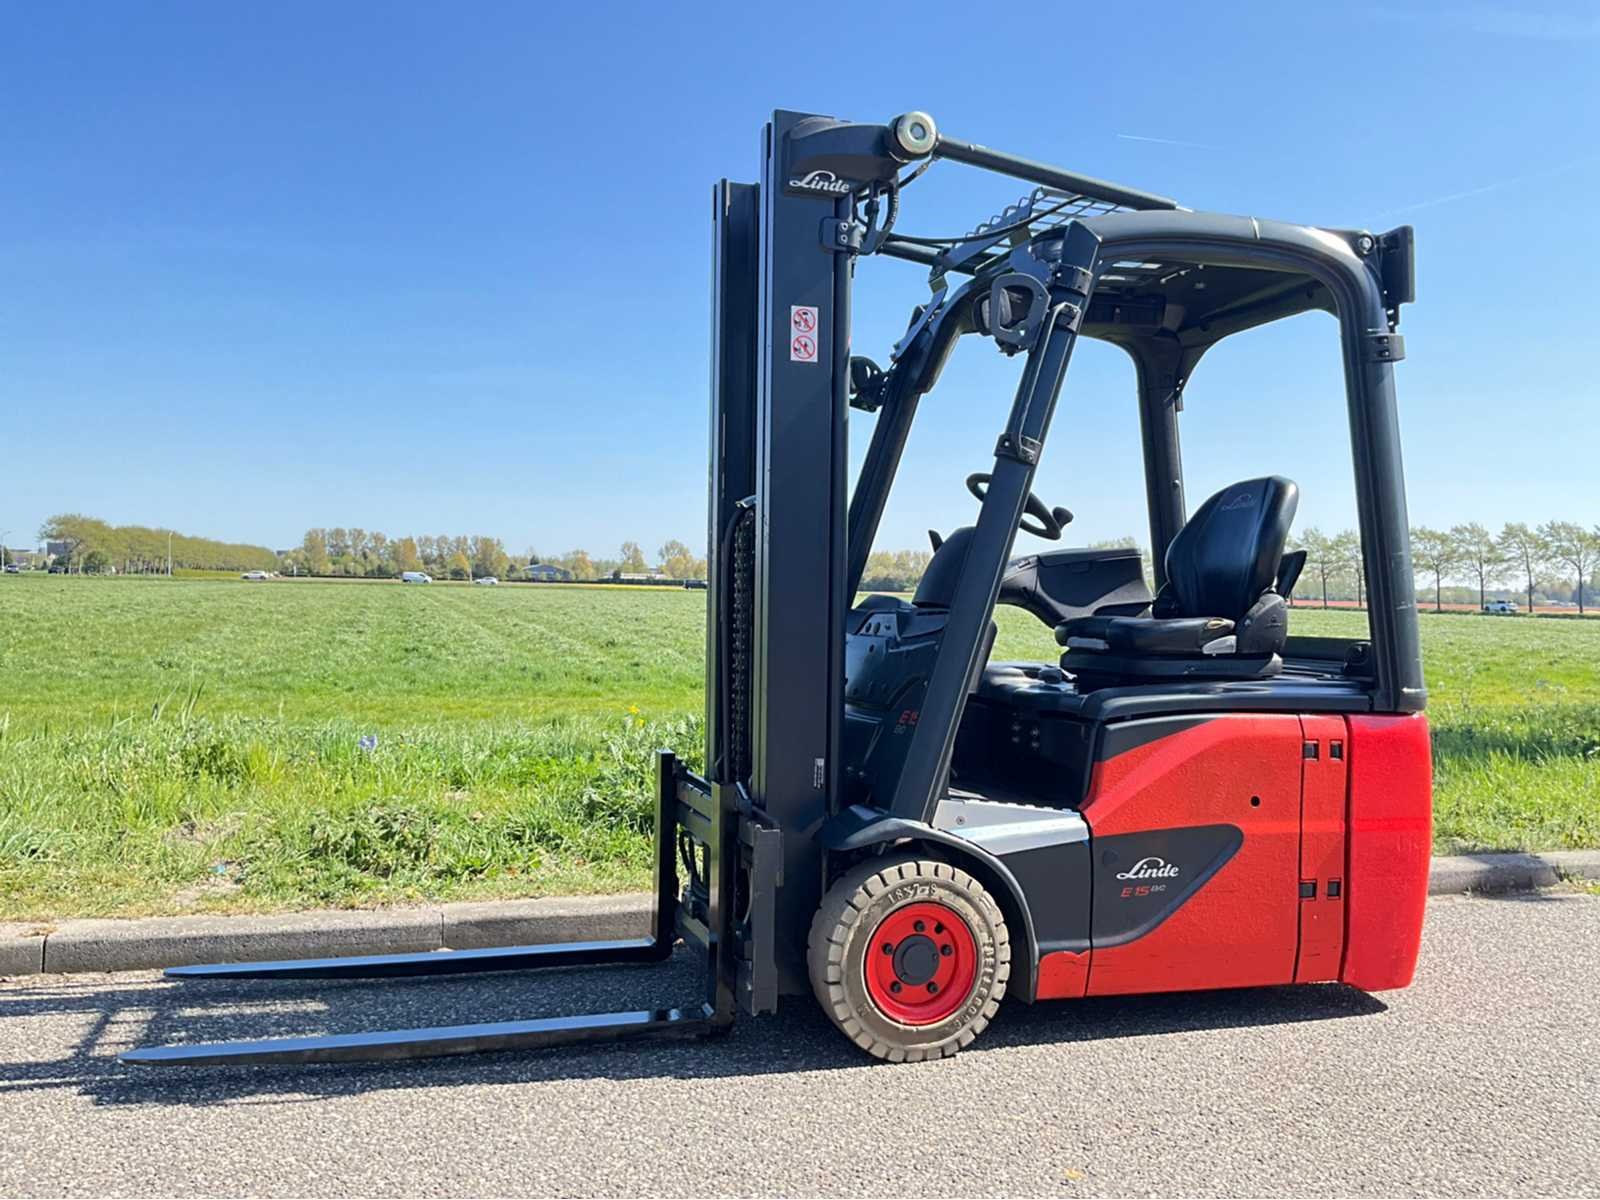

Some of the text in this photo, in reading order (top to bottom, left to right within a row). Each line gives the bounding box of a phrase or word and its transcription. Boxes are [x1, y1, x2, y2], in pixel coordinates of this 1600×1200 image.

[789, 170, 850, 193] Linde
[1116, 856, 1179, 880] Linde
[1120, 887, 1133, 898] E
[1135, 885, 1151, 896] 15
